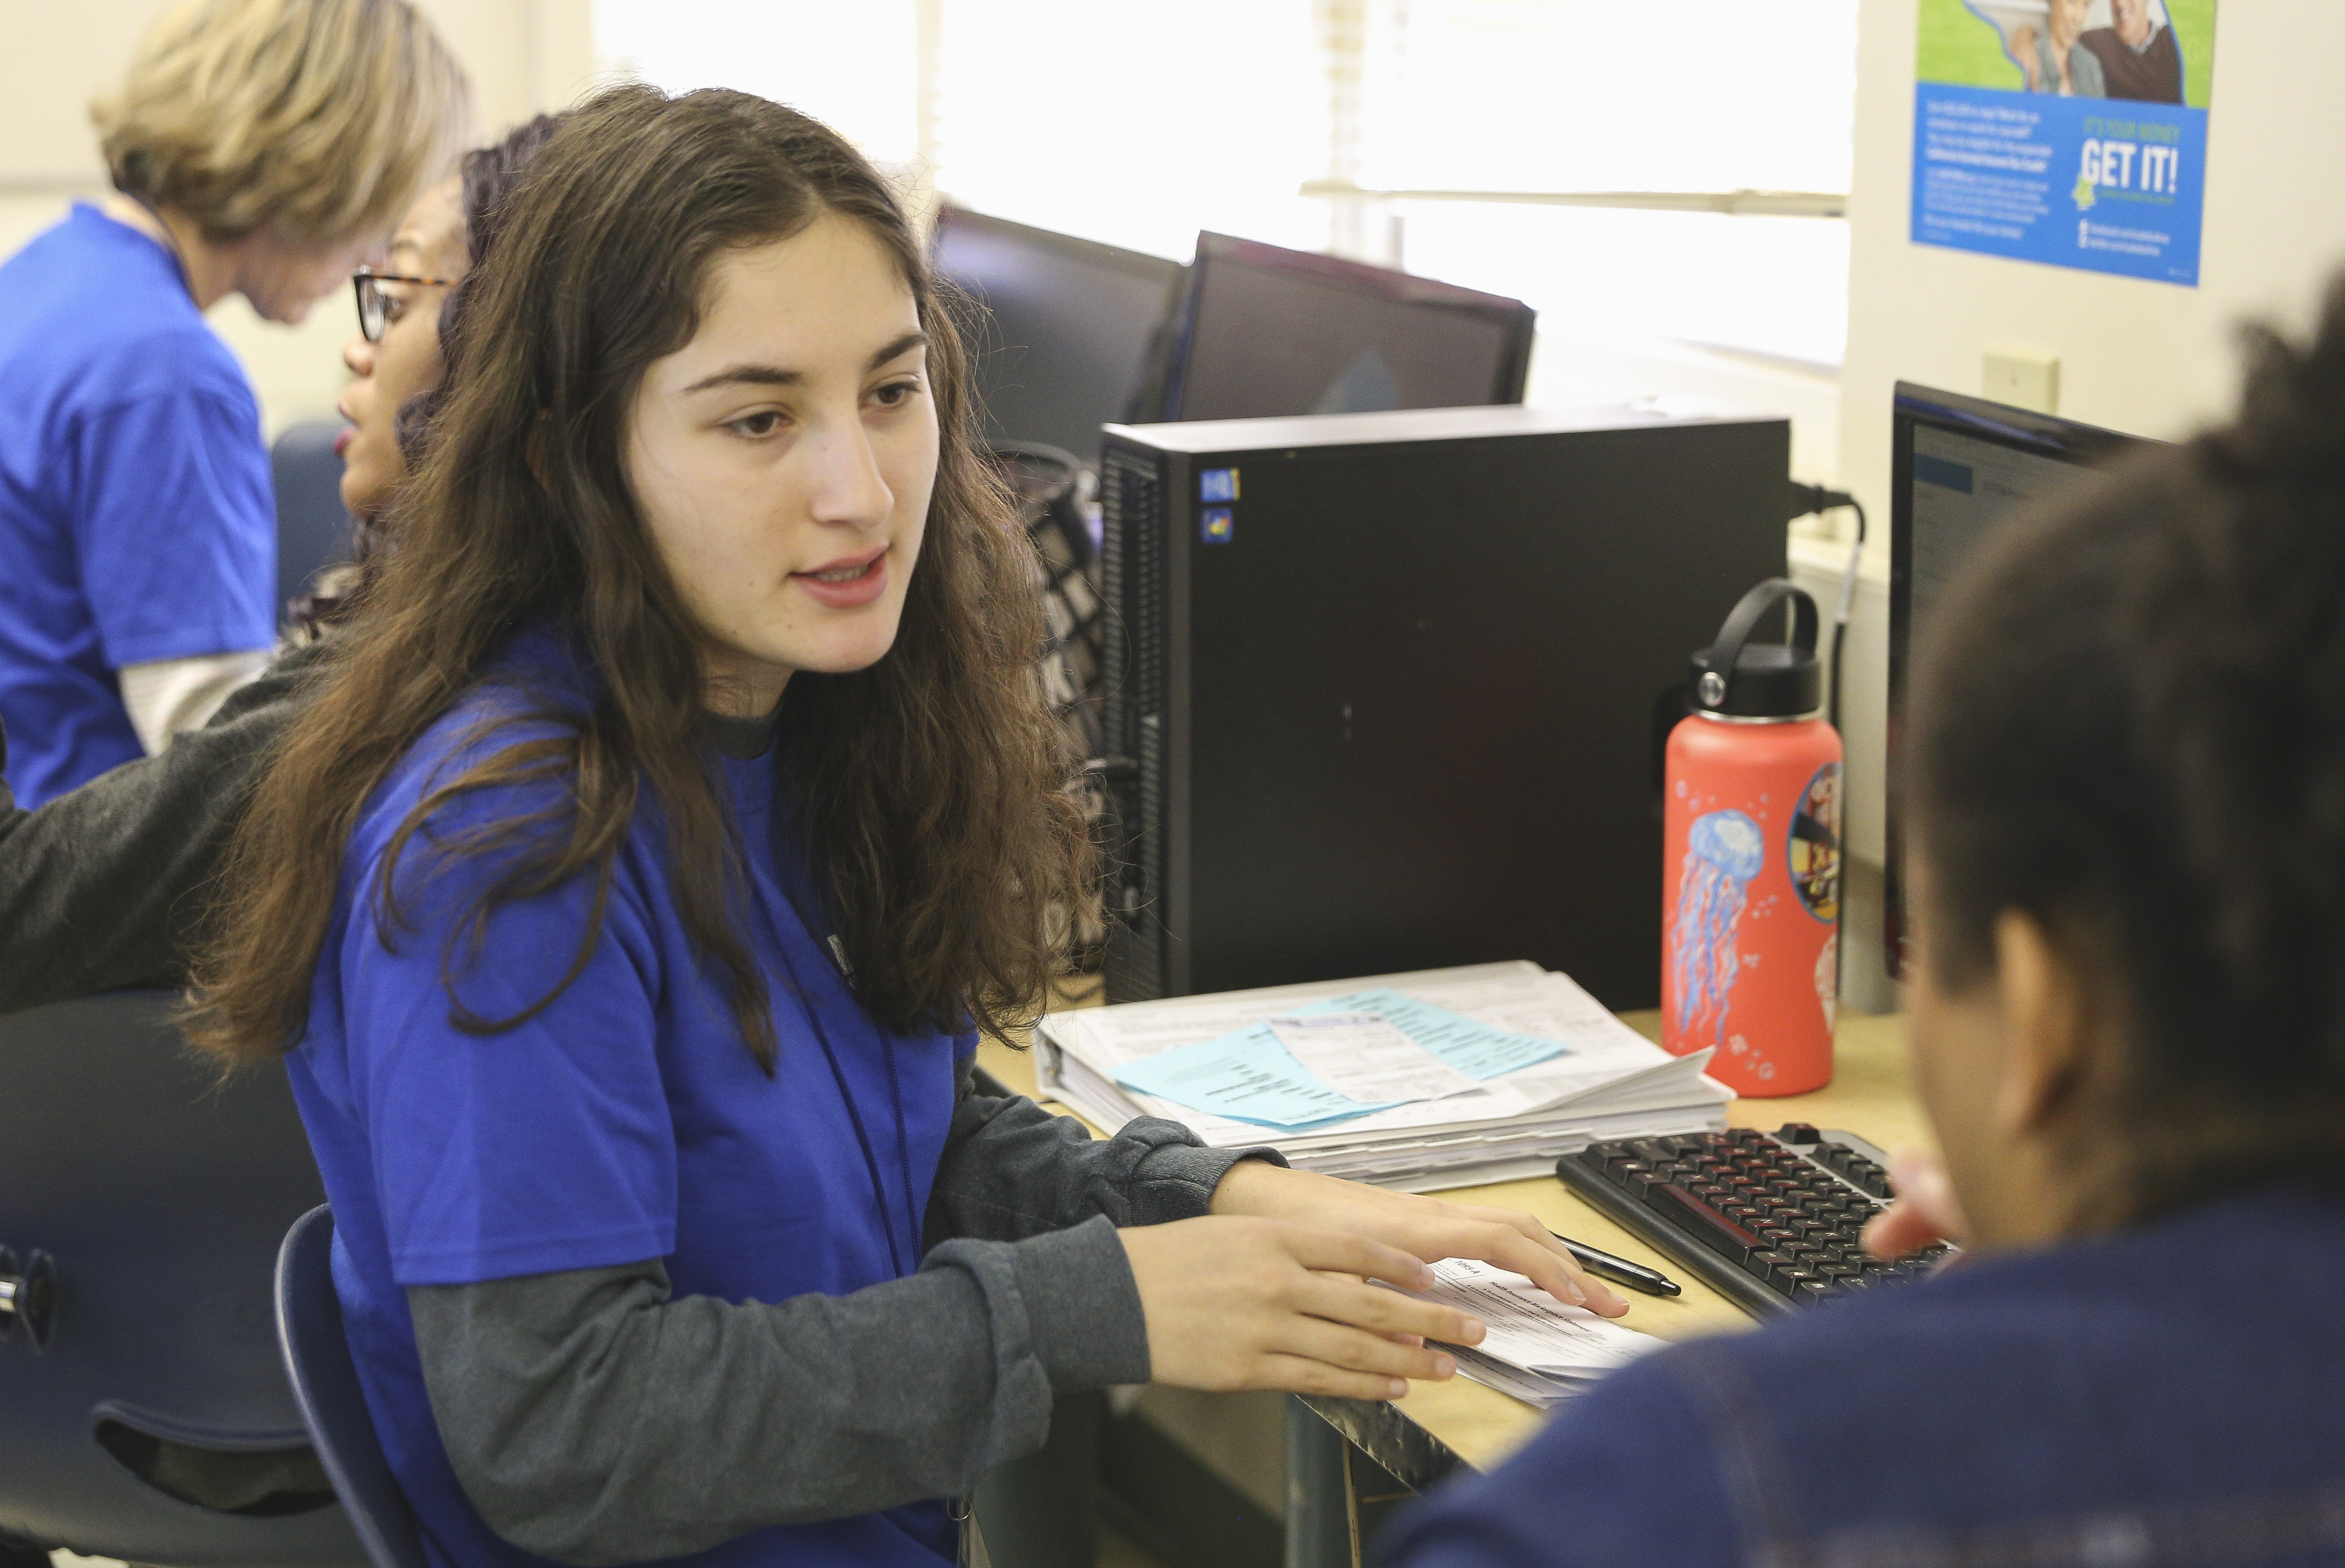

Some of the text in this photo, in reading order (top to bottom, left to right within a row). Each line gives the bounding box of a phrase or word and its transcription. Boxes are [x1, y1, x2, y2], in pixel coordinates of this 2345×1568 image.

[2081, 138, 2178, 193] GET IT!
[1455, 1260, 1481, 1274] 1095-A
[1489, 1281, 1508, 1291] Health
[1506, 1290, 1532, 1303] Insurance
[1531, 1302, 1564, 1319] Marketplace
[1562, 1317, 1593, 1332] Statement
